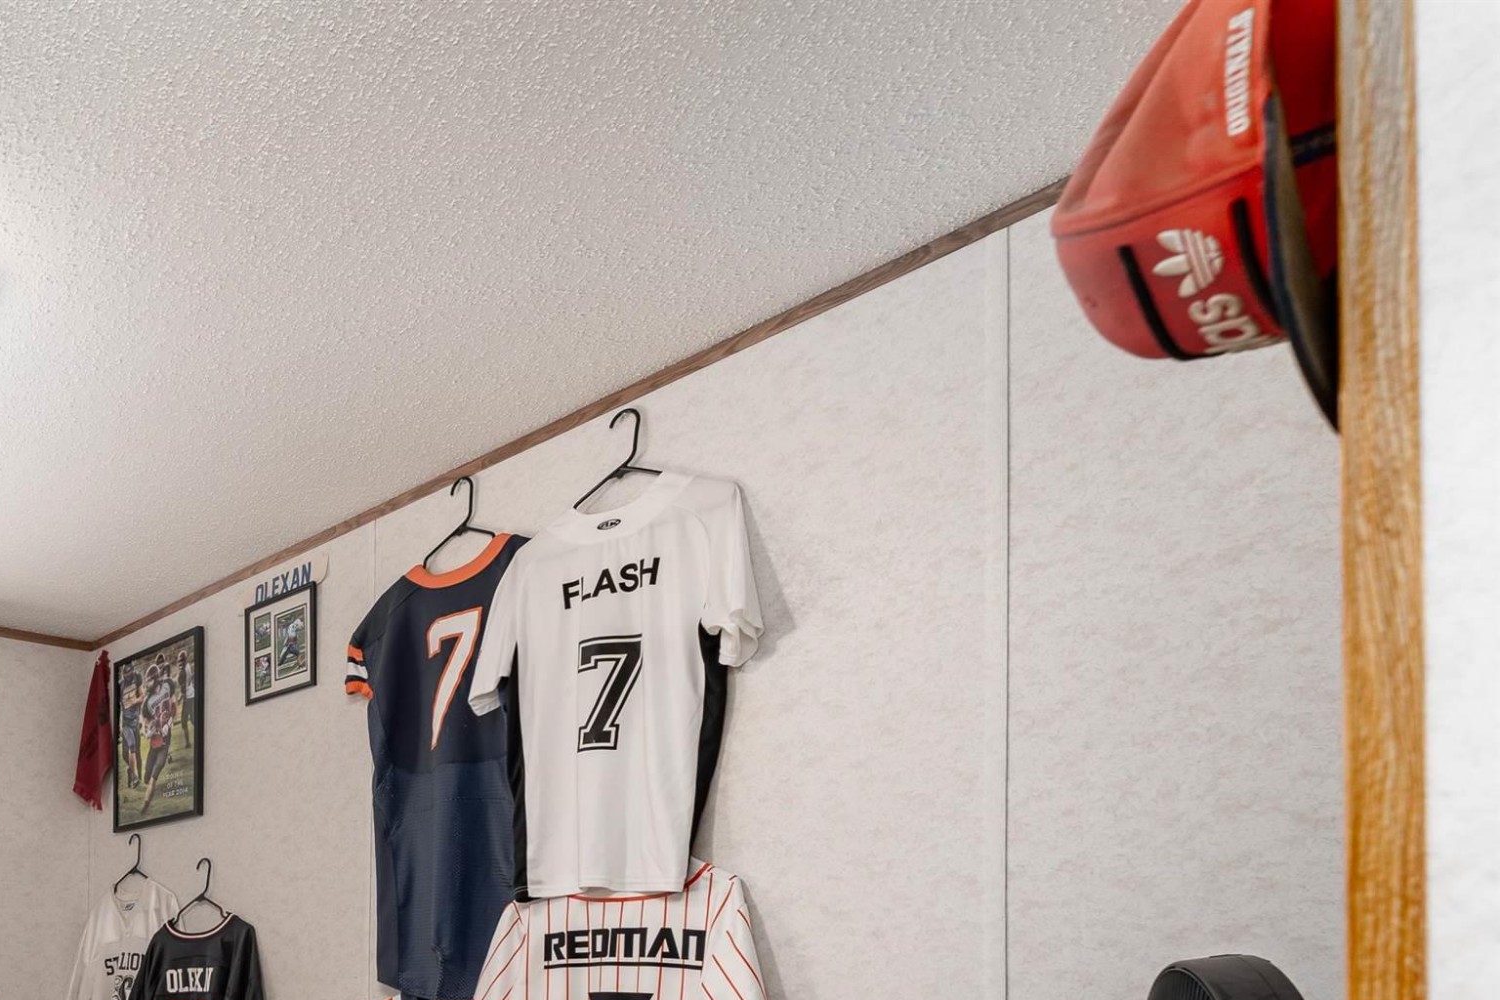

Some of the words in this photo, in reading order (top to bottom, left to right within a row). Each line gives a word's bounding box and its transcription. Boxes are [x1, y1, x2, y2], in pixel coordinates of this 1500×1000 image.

[255, 560, 312, 606] OLEXAN
[562, 556, 660, 609] FLASH
[426, 606, 483, 750] 7
[577, 633, 643, 753] 7
[544, 927, 706, 962] REDMAN
